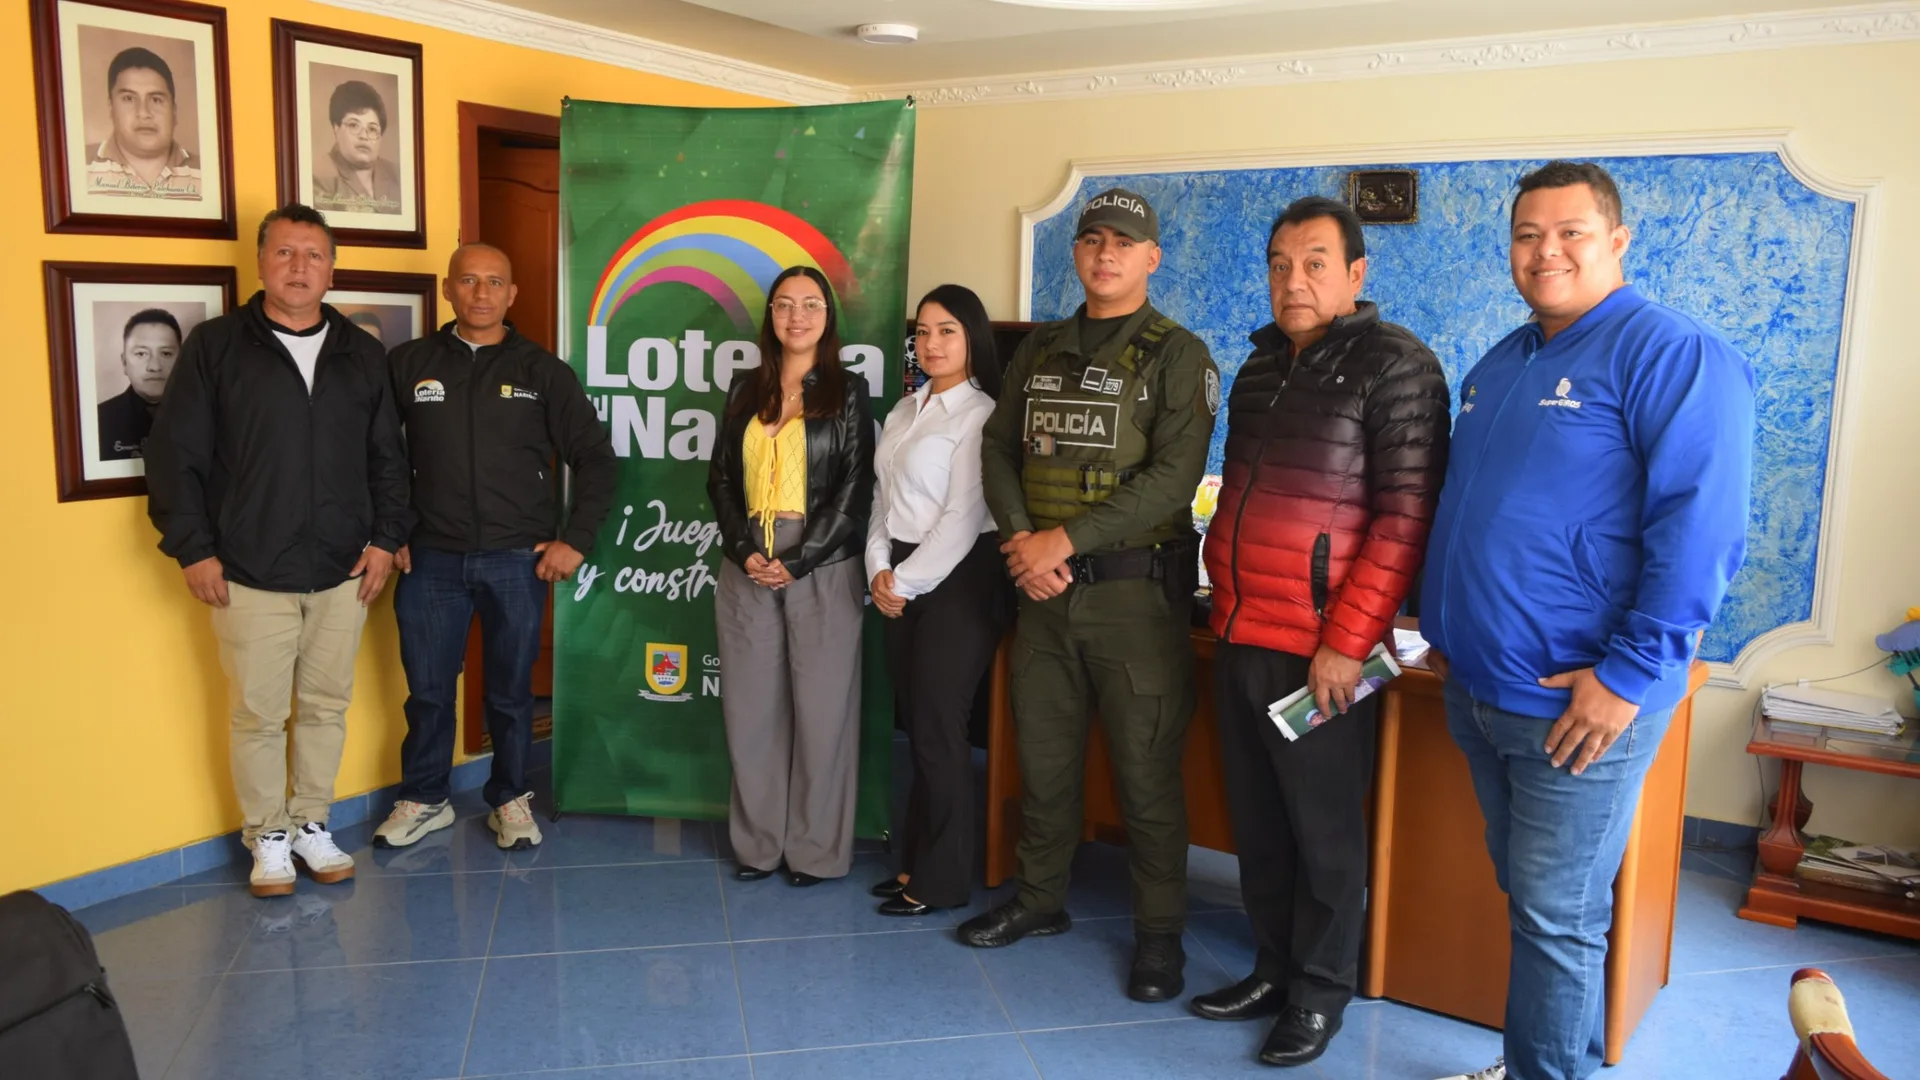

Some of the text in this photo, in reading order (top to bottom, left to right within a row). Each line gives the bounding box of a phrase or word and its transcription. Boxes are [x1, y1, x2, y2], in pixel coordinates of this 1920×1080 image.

[1083, 194, 1145, 218] POLICÍA
[586, 325, 885, 398] Lotea
[1032, 408, 1106, 437] POLICÍA
[574, 562, 606, 602] y
